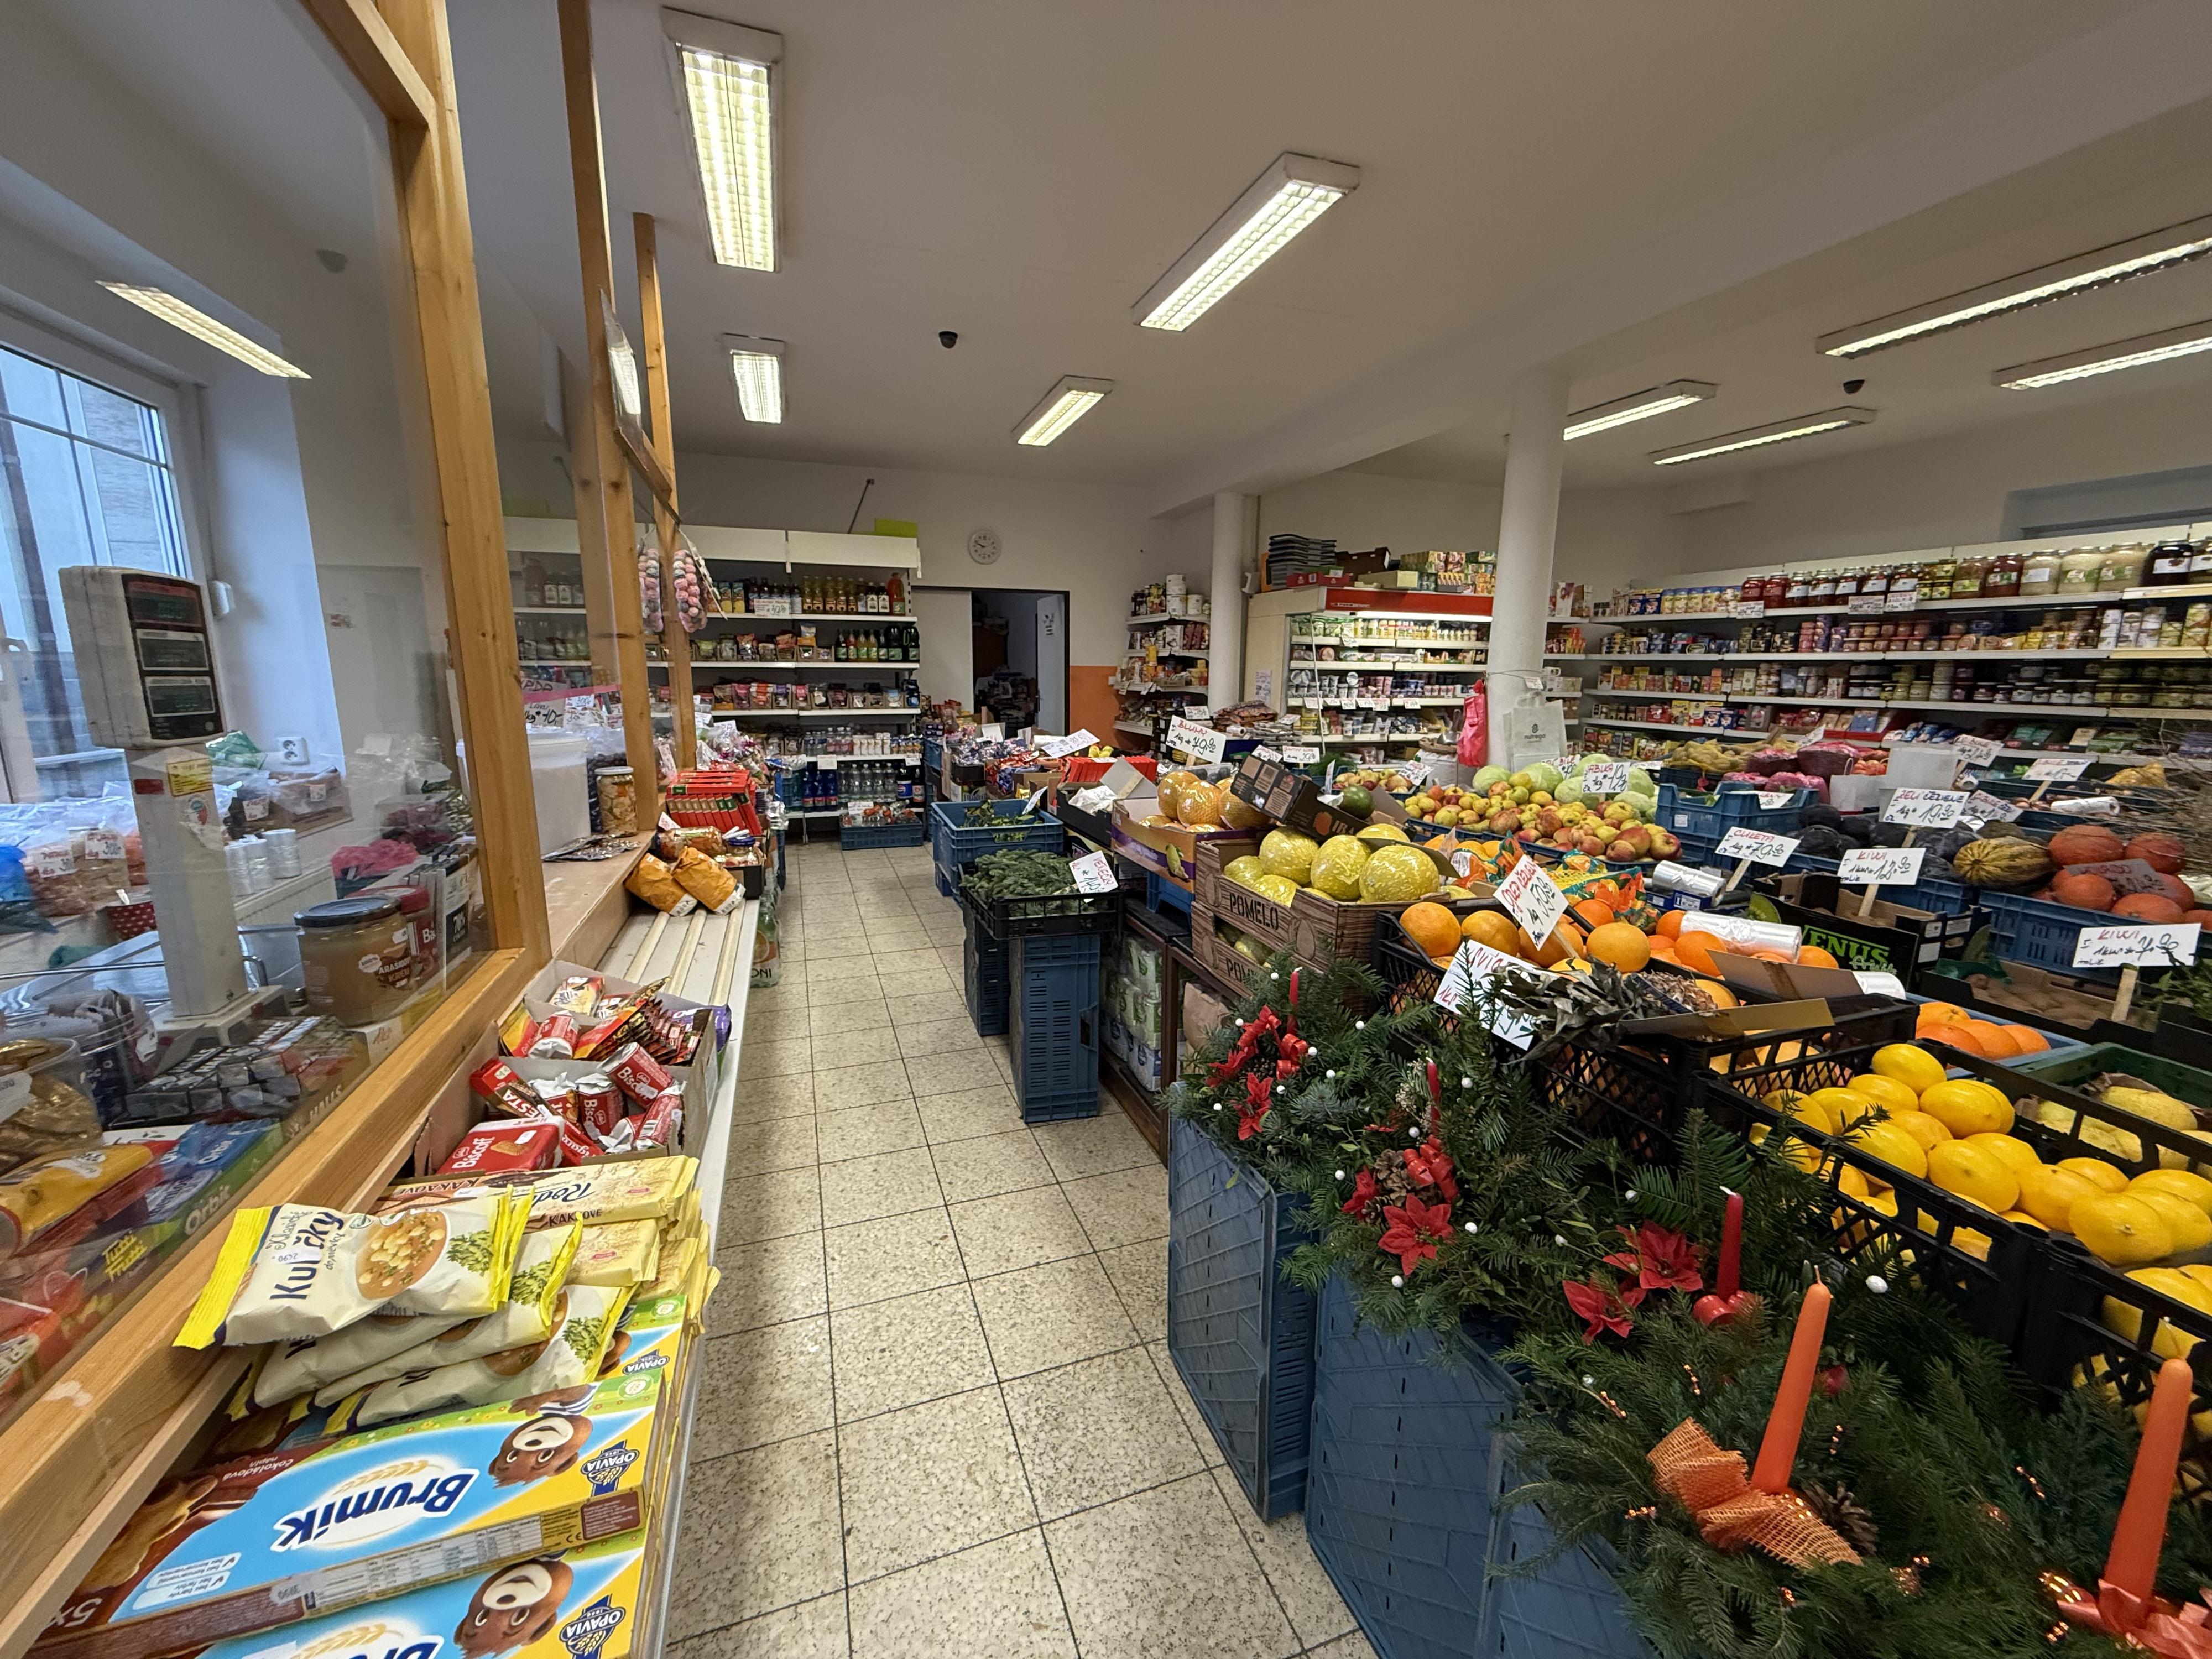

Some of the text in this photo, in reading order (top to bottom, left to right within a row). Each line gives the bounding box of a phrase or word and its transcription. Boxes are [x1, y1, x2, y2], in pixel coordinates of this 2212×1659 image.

[1856, 851, 1887, 861] KIWI
[1229, 892, 1279, 931] POMELO
[2098, 930, 2140, 940] KIWI
[452, 1136, 495, 1168] Biscoff
[185, 1185, 231, 1235] Orbit
[102, 1229, 137, 1265] Tutti
[269, 1212, 345, 1300] Kulčky
[627, 1357, 667, 1374] OPAVIA
[586, 1449, 637, 1470] OPAVIA
[278, 1473, 474, 1547] Brumik
[566, 1609, 622, 1635] OPAVIA
